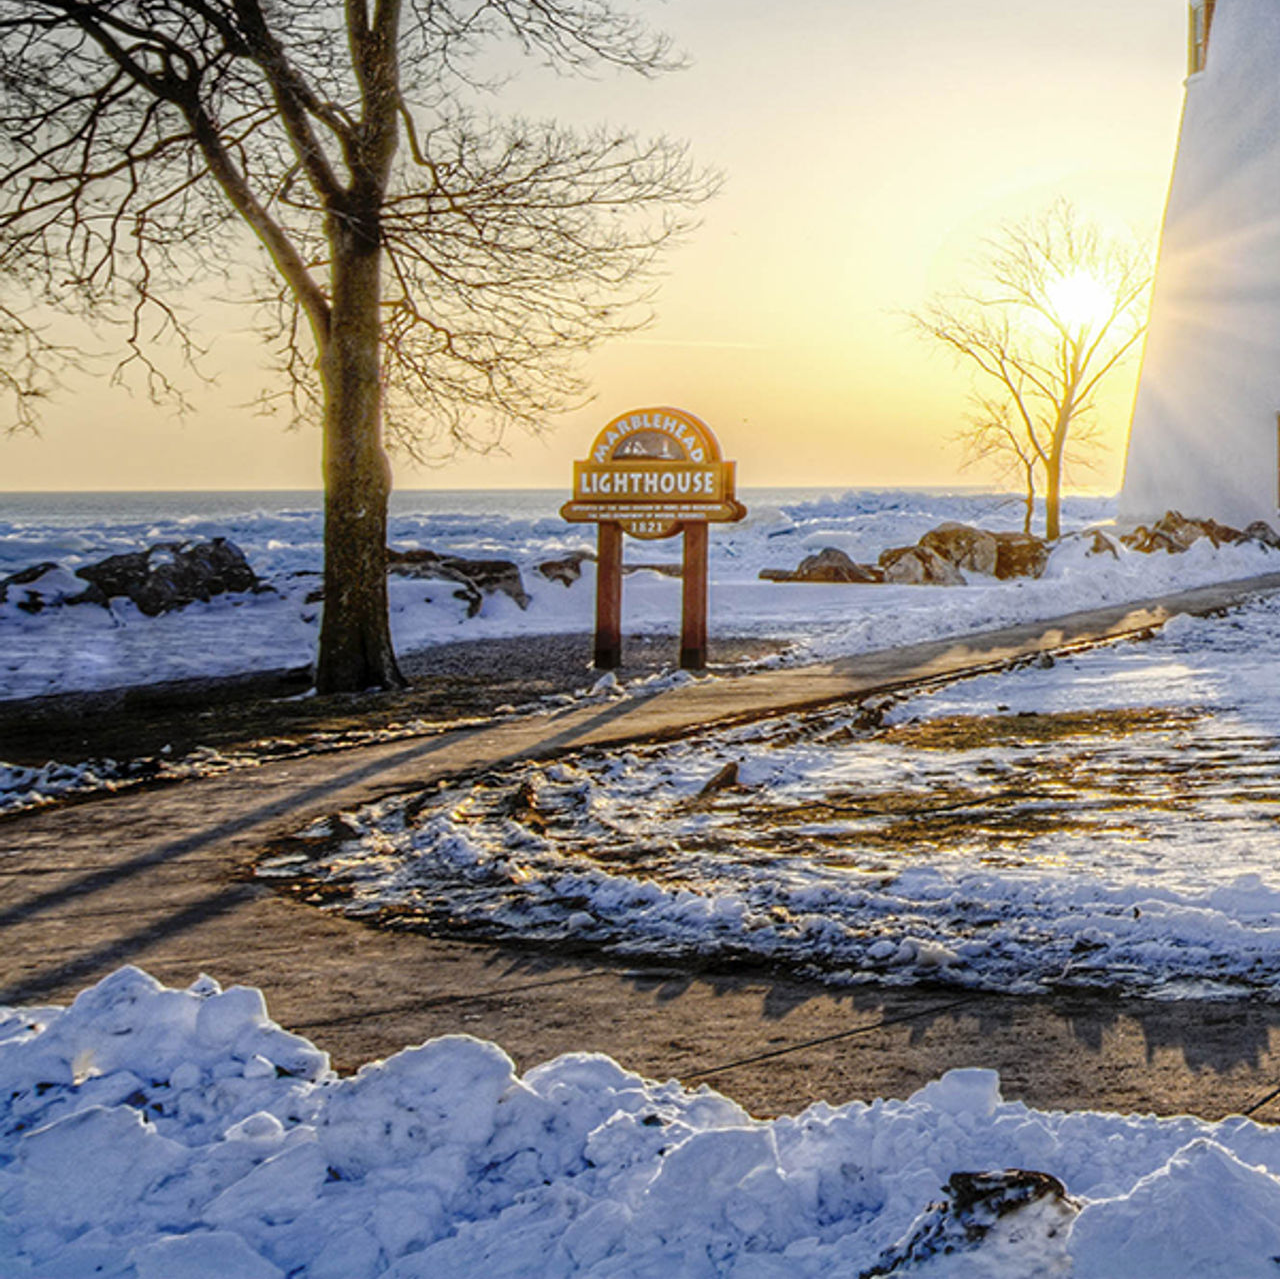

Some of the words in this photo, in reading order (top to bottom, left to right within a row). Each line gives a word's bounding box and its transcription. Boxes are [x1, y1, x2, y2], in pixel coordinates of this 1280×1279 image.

[594, 414, 704, 463] MARBLEHEAD
[581, 472, 713, 493] LIGHTHOUSE
[632, 522, 662, 533] 1821
